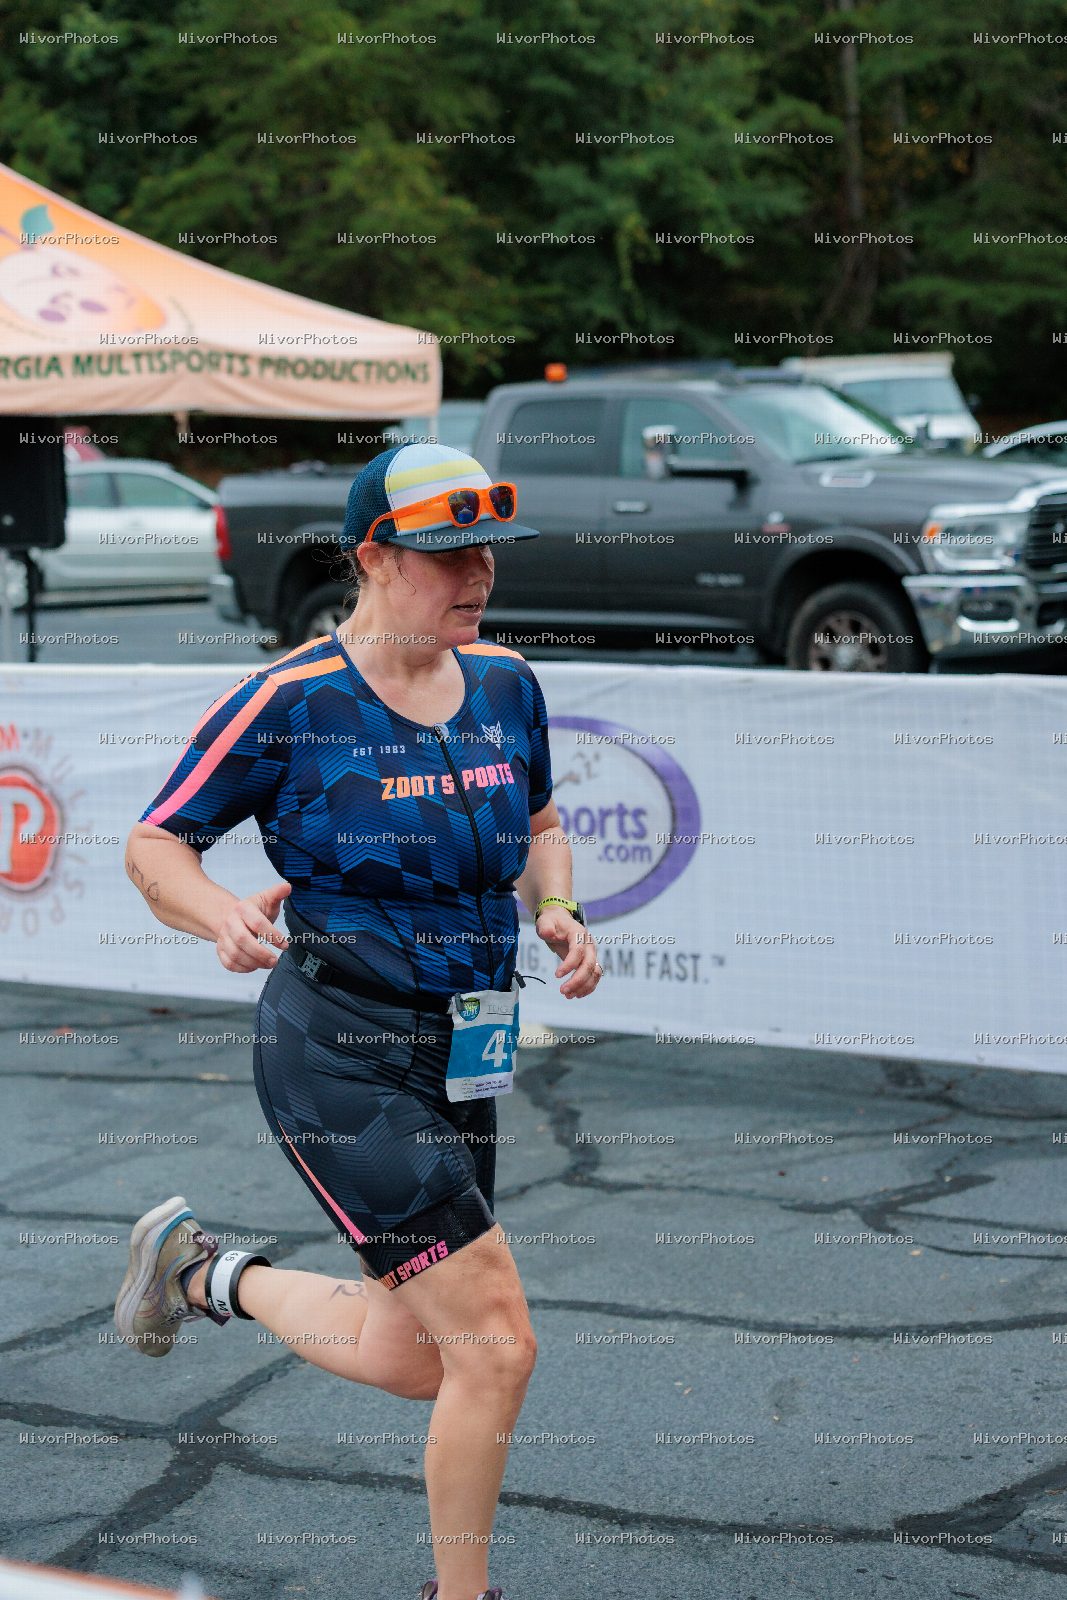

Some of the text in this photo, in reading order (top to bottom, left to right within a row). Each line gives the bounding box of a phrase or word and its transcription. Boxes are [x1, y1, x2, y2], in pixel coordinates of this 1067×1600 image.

[72, 348, 249, 378] MULTISPORTS
[258, 355, 430, 385] PRODUCTIONS
[380, 745, 406, 754] 1983
[381, 775, 436, 801] ZOOT
[597, 843, 653, 864] .com
[396, 1240, 449, 1282] SPORTS
